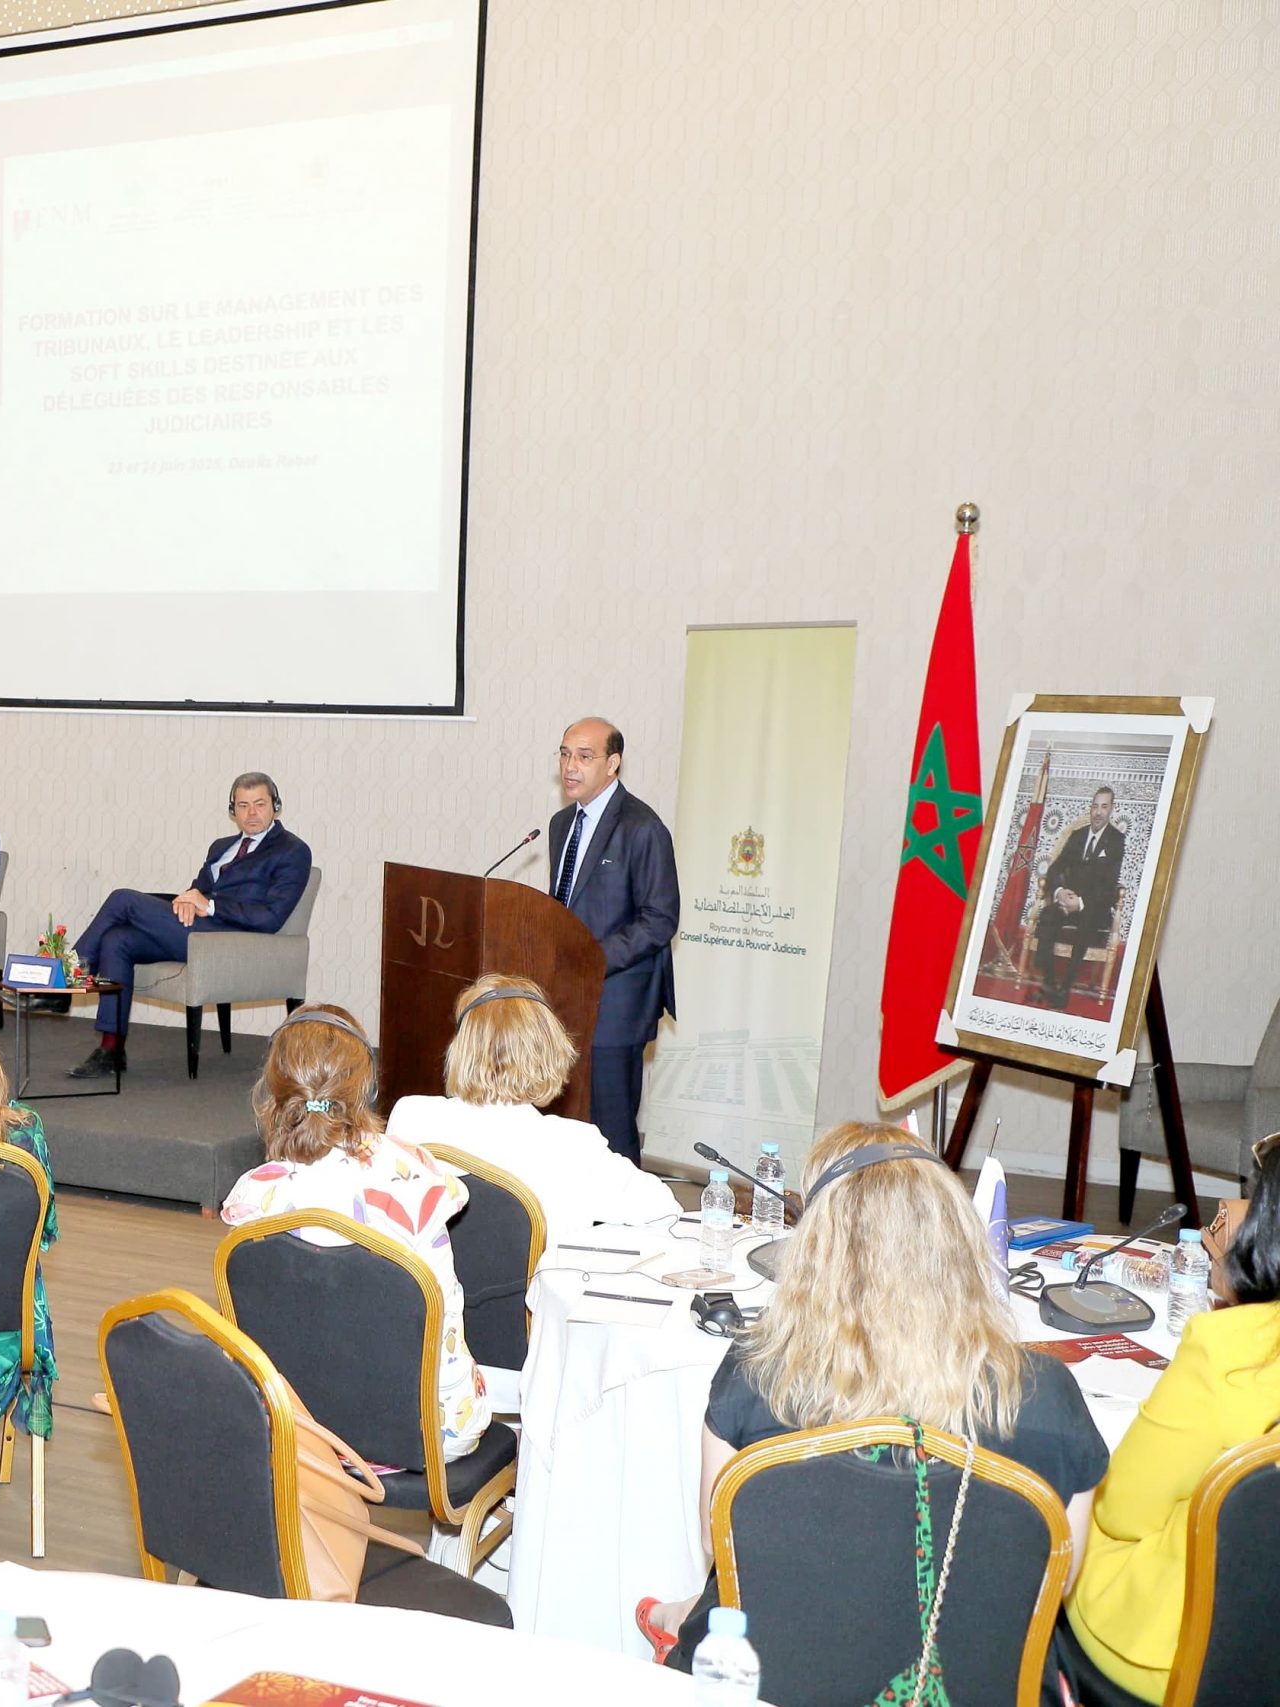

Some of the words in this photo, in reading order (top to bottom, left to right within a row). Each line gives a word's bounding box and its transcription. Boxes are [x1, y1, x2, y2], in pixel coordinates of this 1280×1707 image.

[18, 307, 130, 332] FORMATION
[137, 303, 177, 323] SUR
[185, 300, 209, 320] LE
[215, 288, 370, 317] MANAGEMENT
[377, 282, 424, 305] DES
[157, 330, 182, 349] LE
[187, 320, 320, 347] LEADERSHIP
[327, 318, 352, 338] ET
[361, 314, 405, 335] LES
[70, 363, 122, 383] SOFT
[129, 358, 197, 380] SKILLS
[312, 346, 359, 368] AUX
[167, 386, 208, 406] DES
[213, 374, 390, 402] RESPONSABLES
[144, 408, 273, 435] JUDICIAIRES
[680, 931, 702, 941] Conseil
[703, 933, 735, 946] Supérieur
[736, 939, 745, 948] du
[745, 940, 771, 951] Pouvoir
[772, 942, 807, 956] Judiciaire
[709, 922, 741, 934] Royaume
[742, 926, 751, 935] du
[751, 928, 774, 938] Maroc
